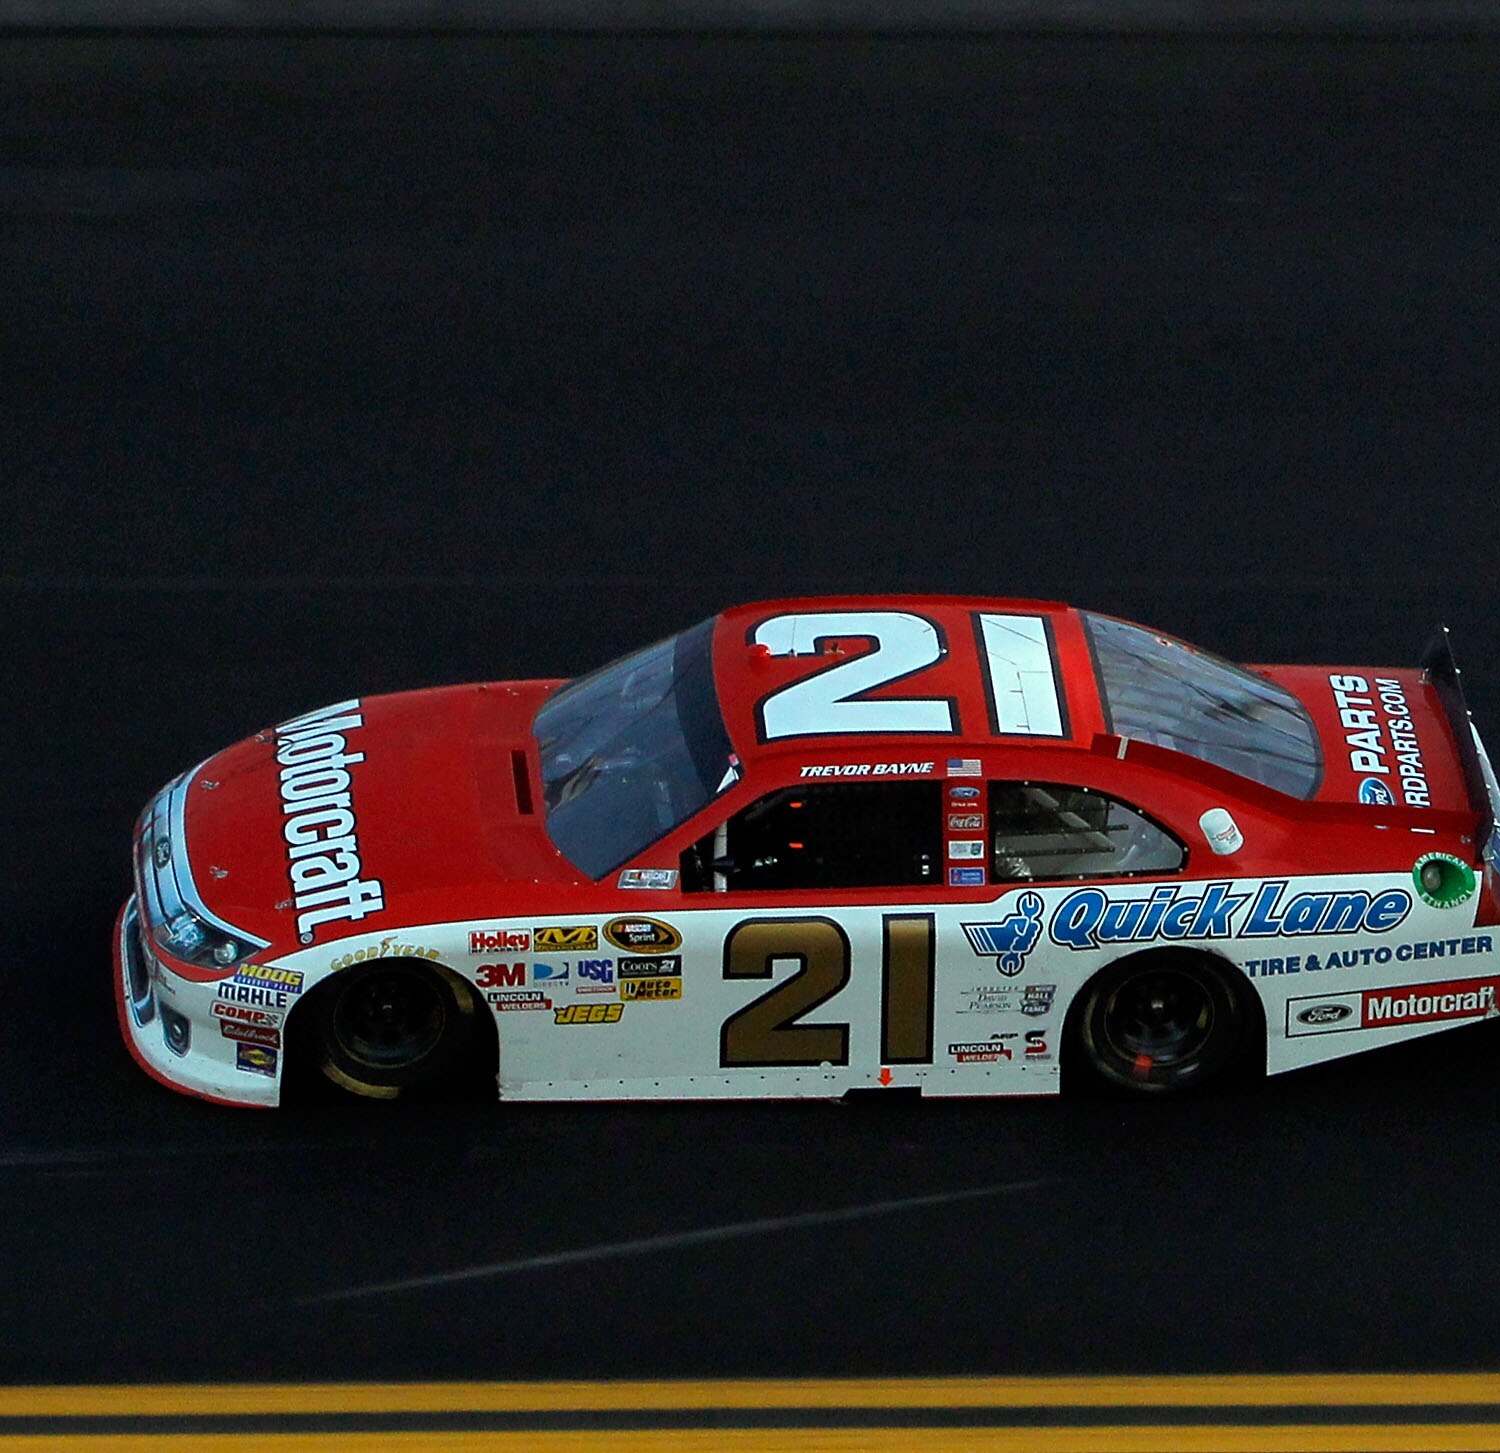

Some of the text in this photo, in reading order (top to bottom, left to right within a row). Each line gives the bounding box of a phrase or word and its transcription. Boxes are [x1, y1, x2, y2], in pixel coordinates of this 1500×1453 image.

[745, 609, 1072, 745] 21
[1329, 674, 1390, 773] PARTS
[1375, 678, 1431, 808] RDPARTS.COM
[800, 762, 934, 777] TREVOR BAYNE
[276, 699, 384, 933] Motorcraft
[1415, 852, 1467, 870] AMERICAN
[1050, 880, 1412, 950] Quick Lane
[471, 931, 530, 951] Holley
[629, 933, 655, 943] Sprint
[331, 945, 440, 971] GOODYEAR
[621, 960, 658, 971] Coors
[1240, 936, 1493, 978] TIRE & AUTO CENTER
[238, 963, 303, 985] MOOG
[475, 963, 526, 988] 3M
[578, 959, 614, 984] USG
[635, 988, 678, 999] Meter
[638, 979, 672, 990] Auto
[720, 913, 935, 1068] 21
[218, 982, 287, 1009] MAHLE
[490, 992, 541, 1002] LINCOLN
[1368, 986, 1497, 1020] Motorcraft
[214, 1003, 266, 1021] COMP
[500, 1002, 547, 1011] WELDERS
[556, 1004, 624, 1024] JEGS
[1308, 1007, 1341, 1022] Ford
[950, 1044, 1001, 1053] LINCOLN
